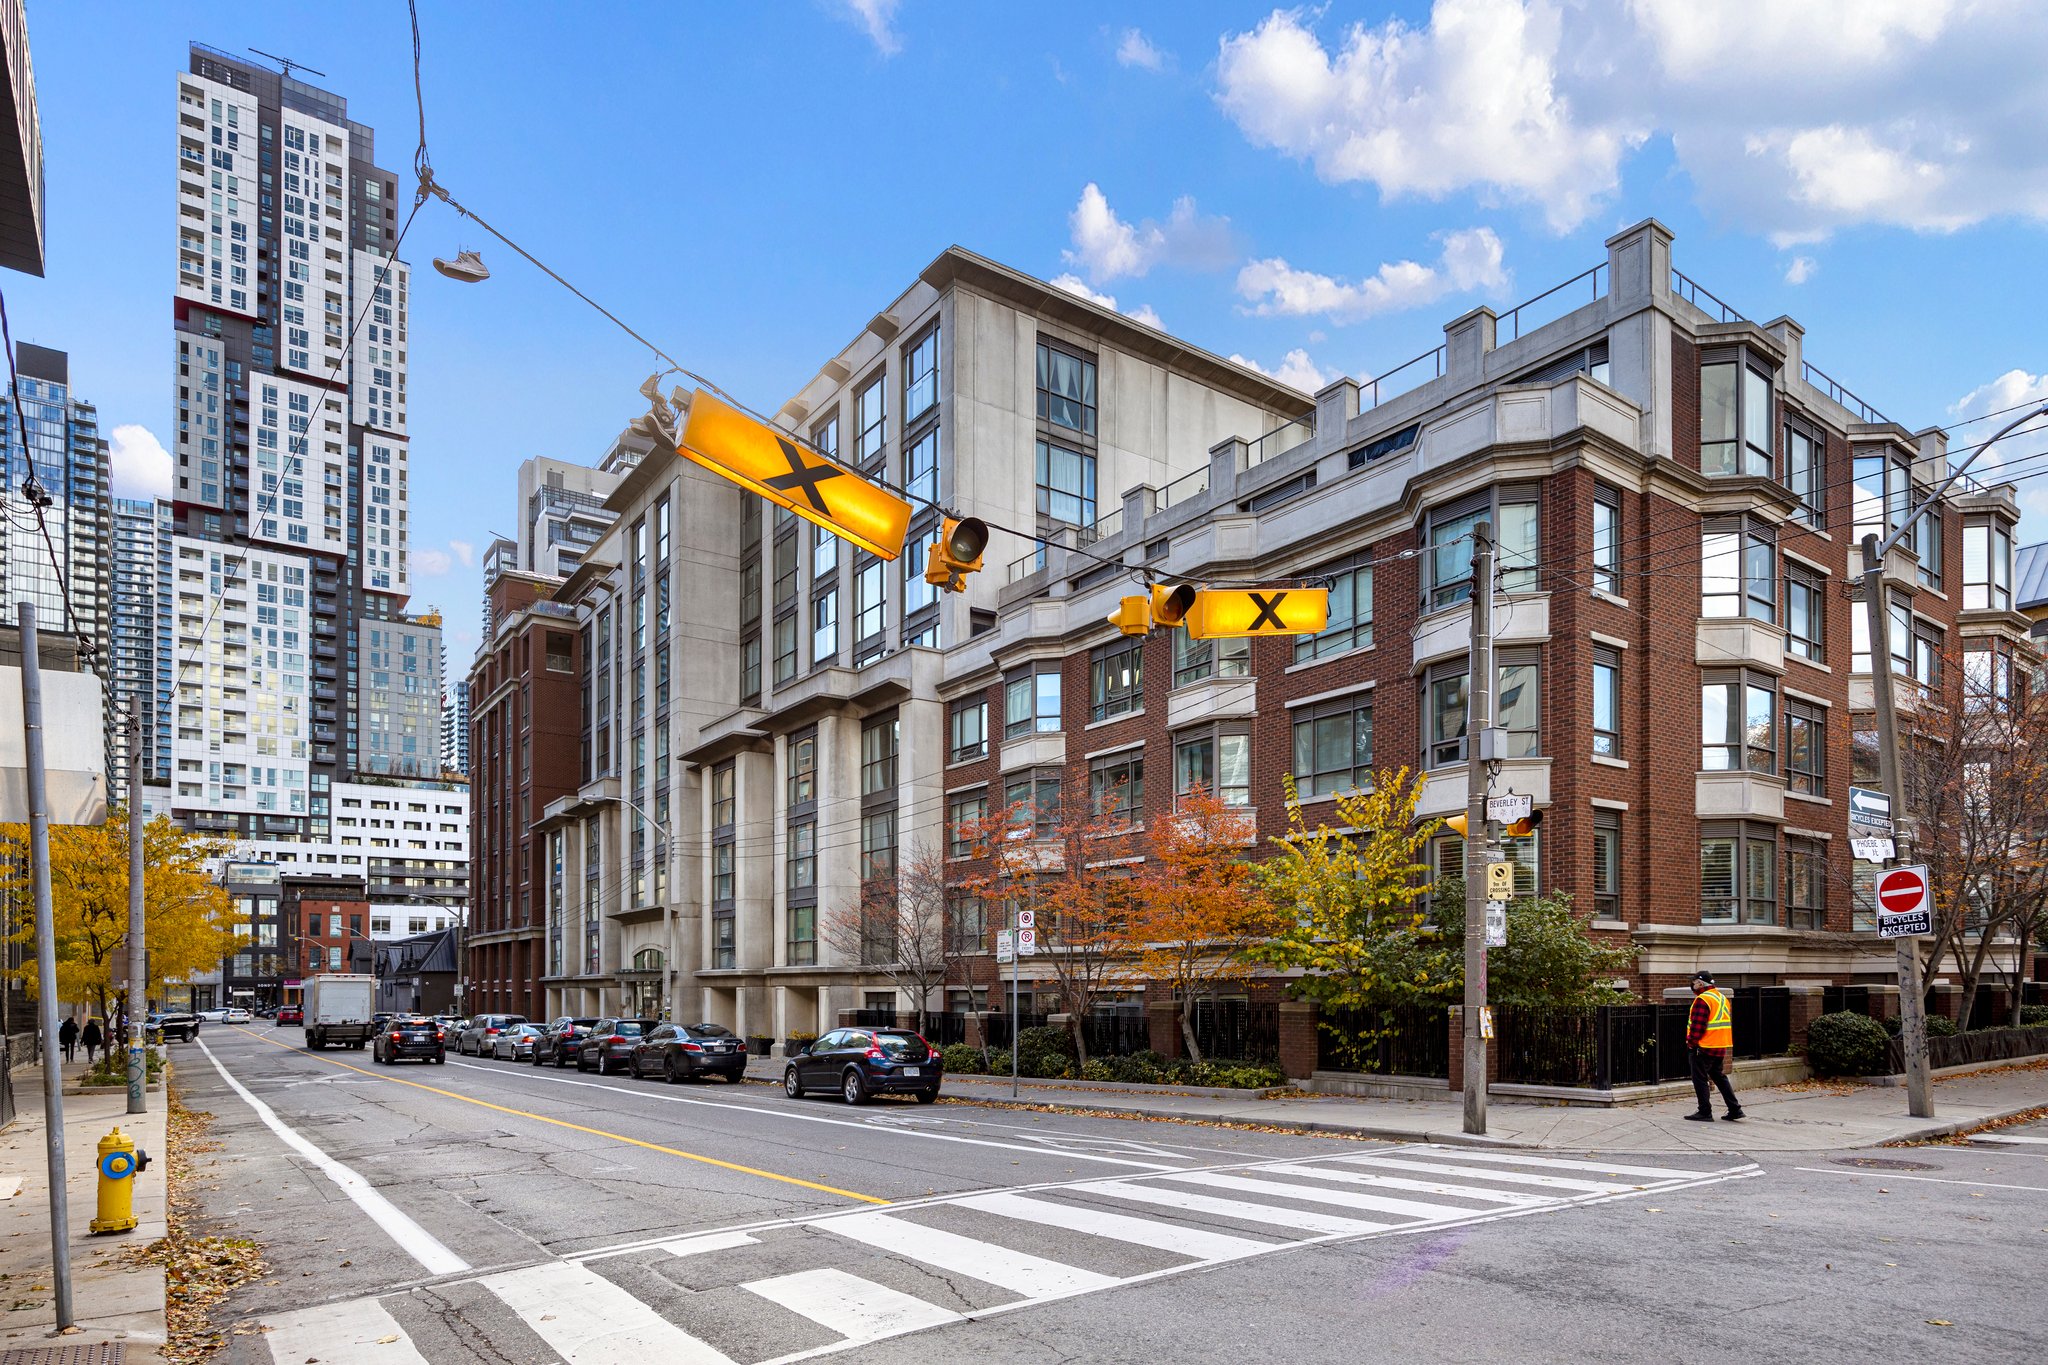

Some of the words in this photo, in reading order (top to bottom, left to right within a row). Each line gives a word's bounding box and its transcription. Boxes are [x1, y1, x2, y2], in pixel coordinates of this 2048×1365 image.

[1490, 799, 1518, 809] BEVERLEY
[1851, 813, 1870, 824] BICYCLES
[1871, 817, 1891, 827] EXCEPTED
[1856, 840, 1878, 848] PHOEBE
[1883, 913, 1924, 925] BICYCLES
